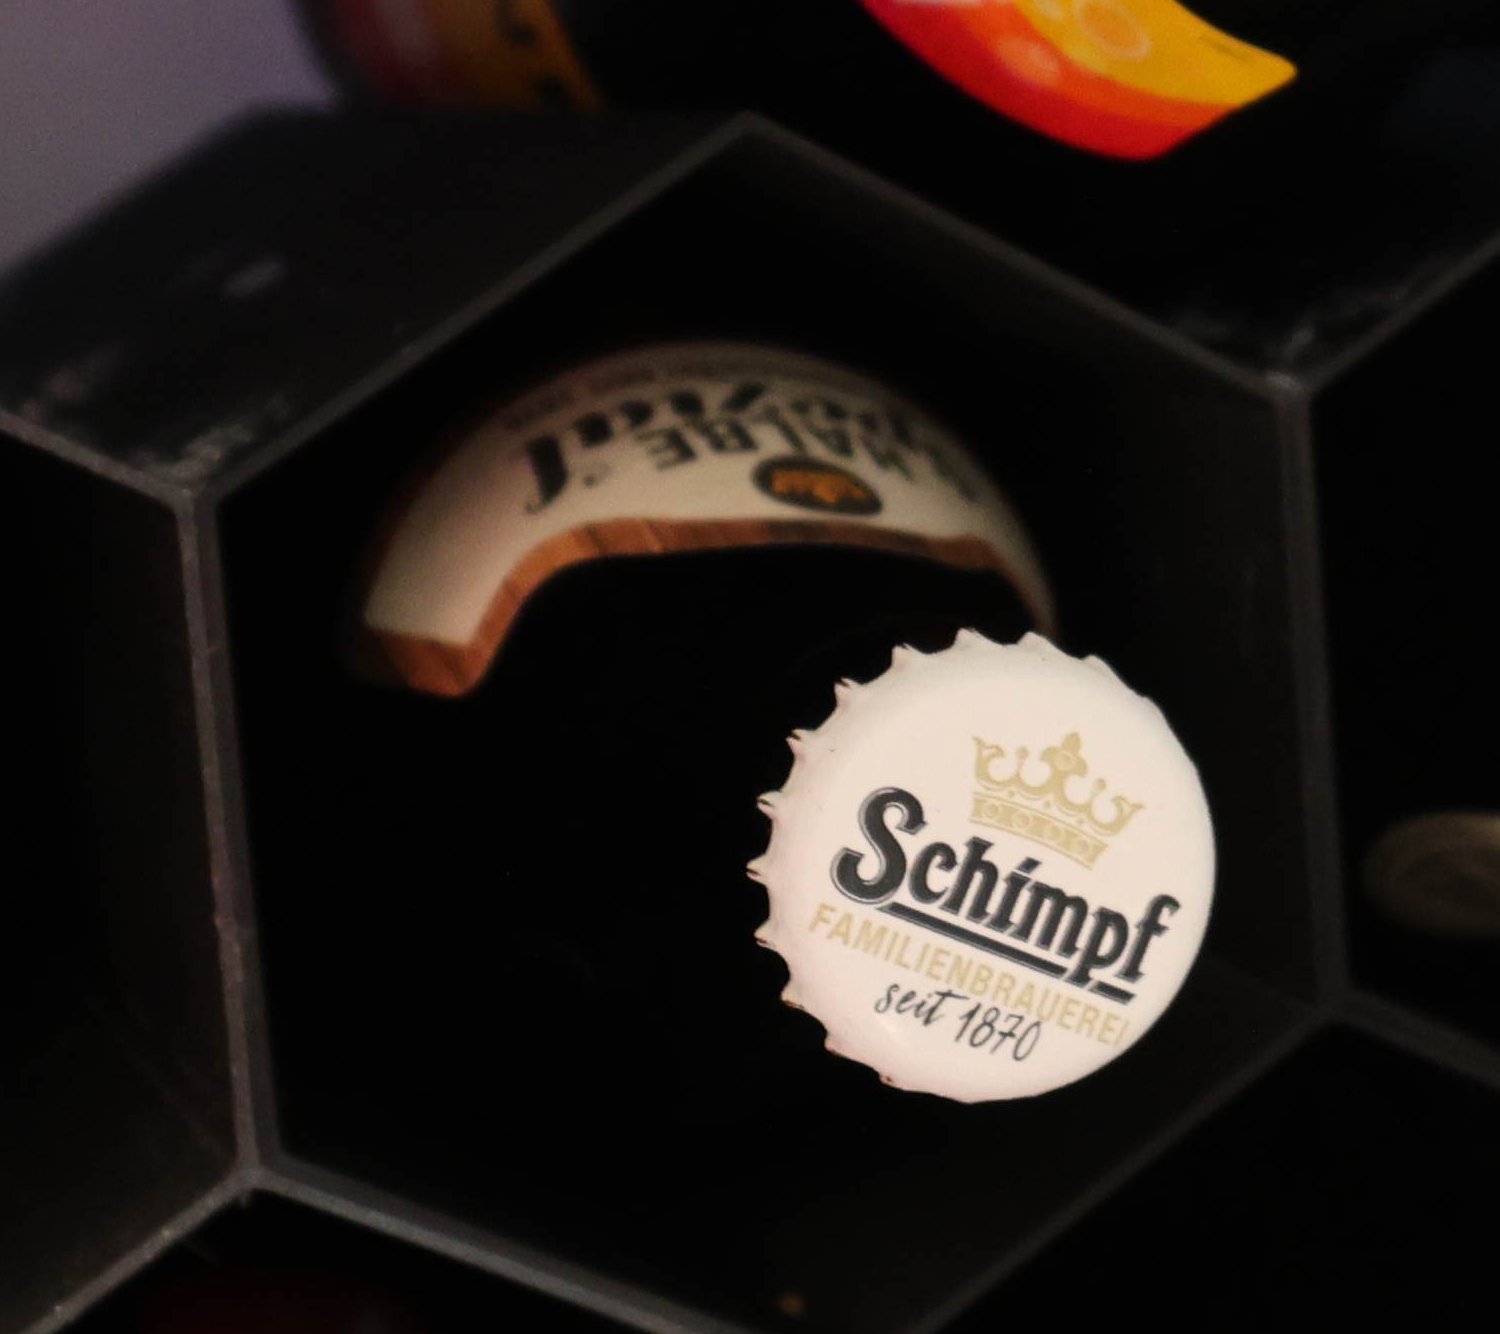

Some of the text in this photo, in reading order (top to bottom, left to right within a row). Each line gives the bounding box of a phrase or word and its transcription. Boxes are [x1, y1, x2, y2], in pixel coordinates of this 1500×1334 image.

[830, 786, 1182, 985] Schimpf
[808, 902, 1130, 1047] FAMILIENBRAUEREI
[874, 980, 1042, 1062] seit 1870
